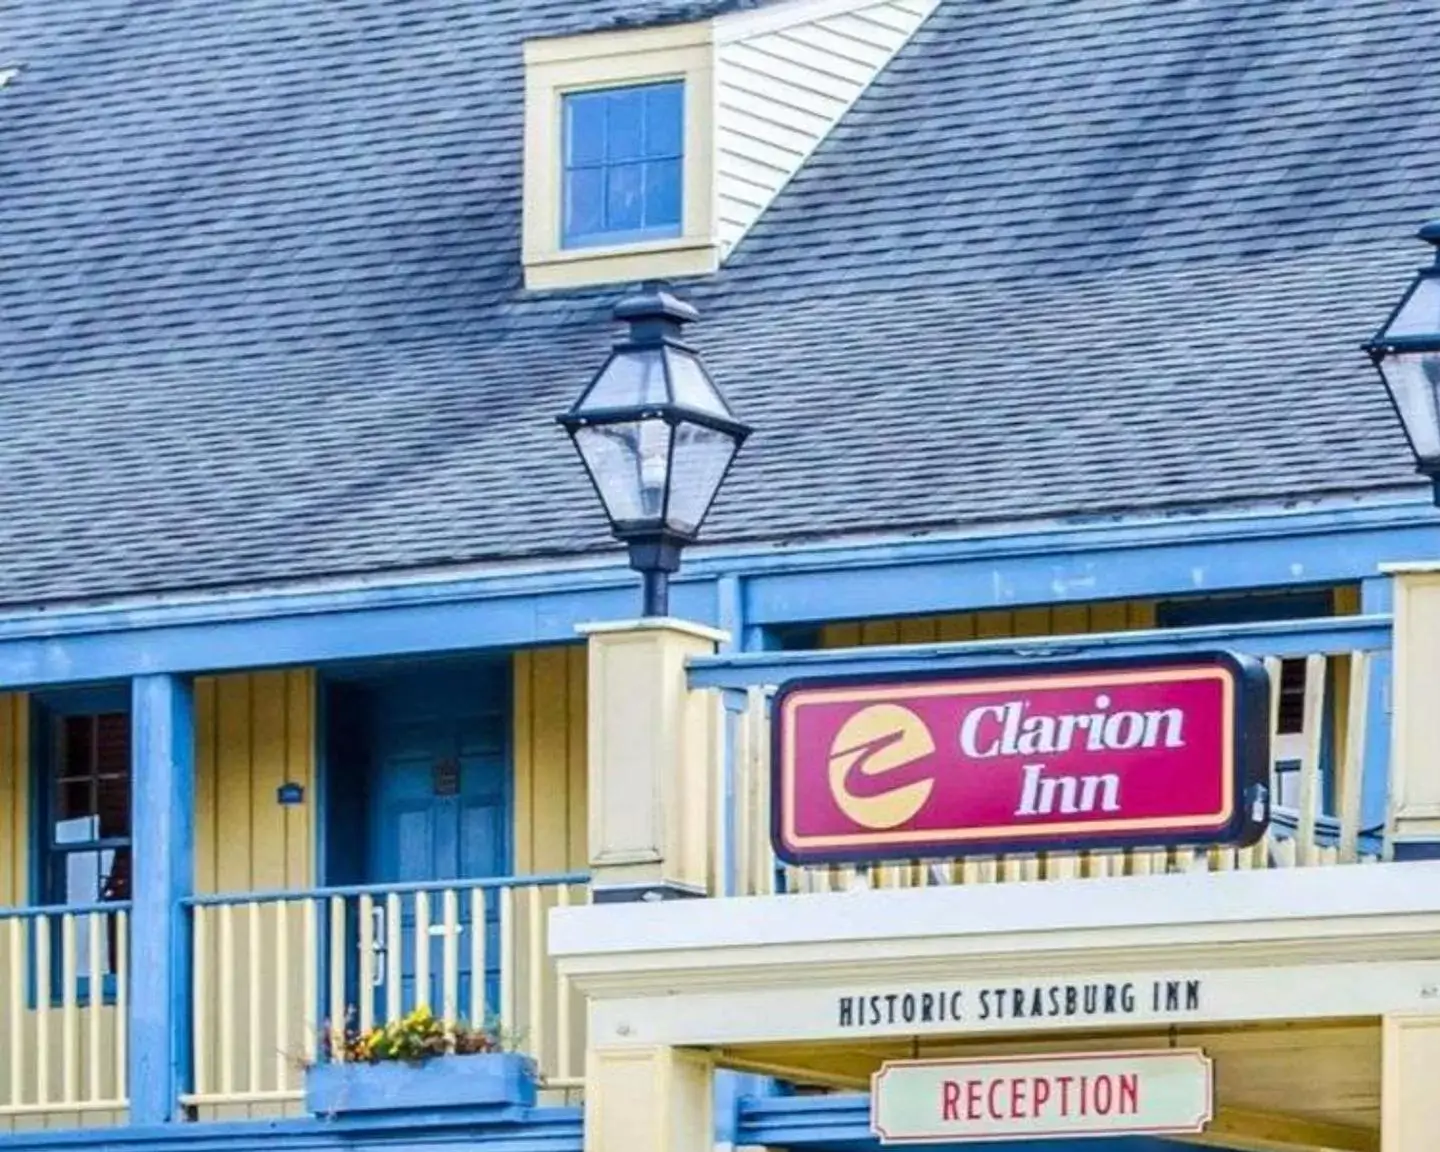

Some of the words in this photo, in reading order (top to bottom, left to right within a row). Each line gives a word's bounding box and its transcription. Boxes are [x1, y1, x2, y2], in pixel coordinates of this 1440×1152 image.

[959, 694, 1186, 760] Clarion
[1014, 763, 1120, 817] Inn
[838, 990, 963, 1027] HISTORIC
[977, 981, 1137, 1020] STRASBURG
[1151, 980, 1202, 1011] INN
[941, 1073, 1140, 1121] RECEPTION
